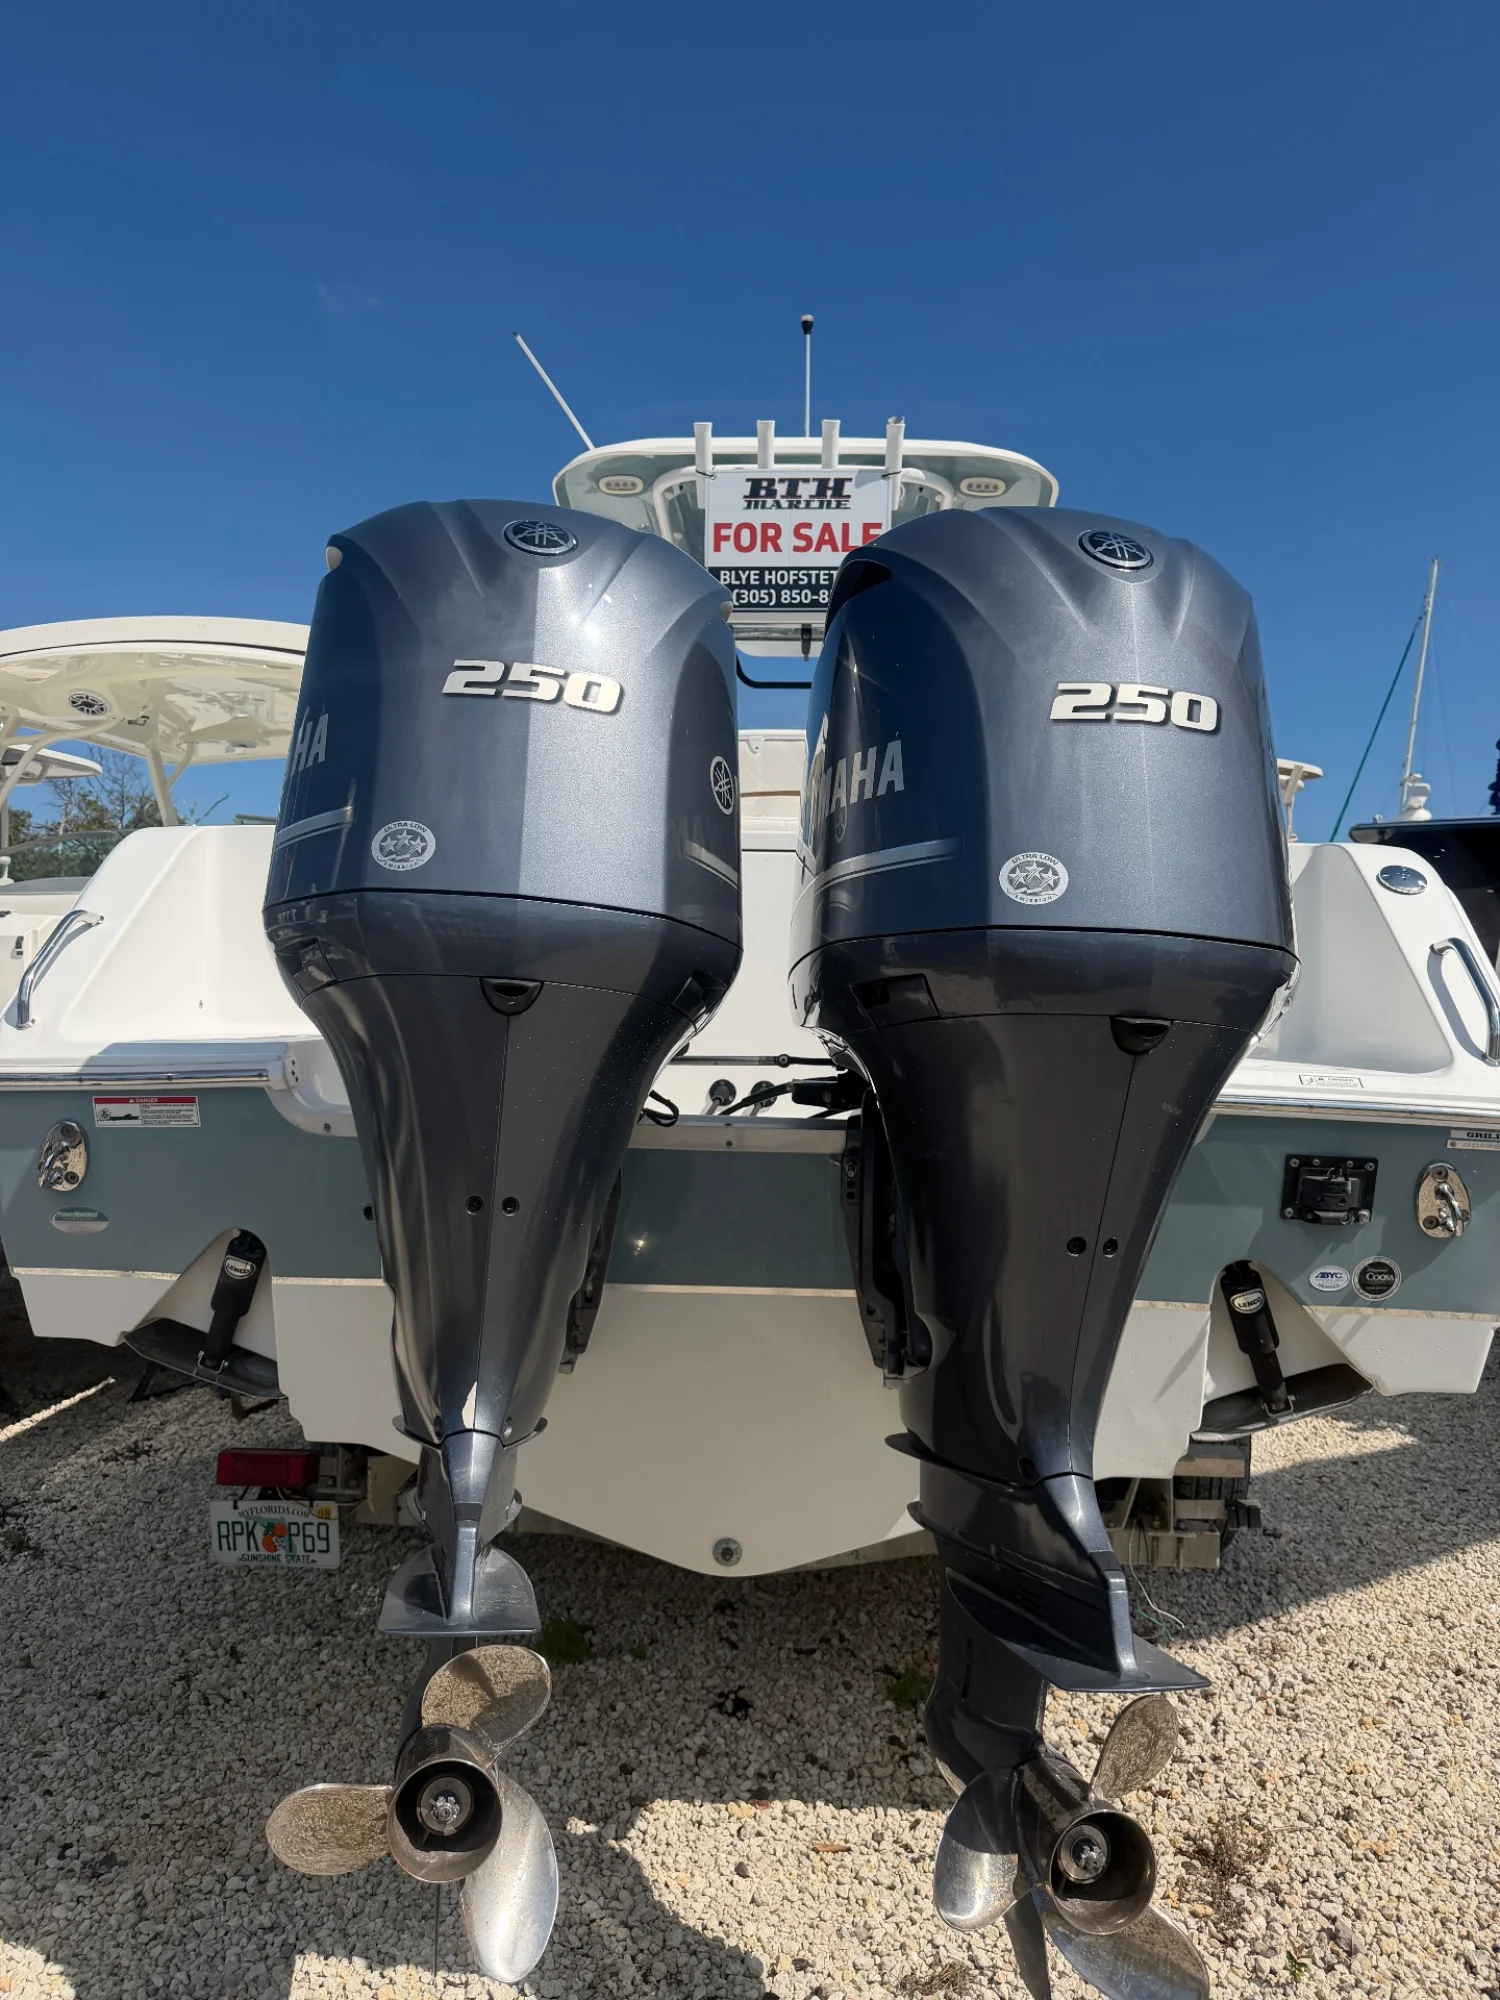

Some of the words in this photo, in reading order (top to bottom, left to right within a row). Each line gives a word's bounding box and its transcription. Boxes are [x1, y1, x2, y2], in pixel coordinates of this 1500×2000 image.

[743, 478, 853, 499] BTH
[742, 500, 852, 510] MARINE
[713, 522, 783, 553] FOR
[792, 522, 882, 553] SALE
[720, 570, 760, 585] BLYE
[732, 589, 776, 606] (305)
[442, 659, 621, 712] 250
[1050, 683, 1217, 731] 250
[1314, 1271, 1344, 1279] ABYC
[1237, 1296, 1261, 1308] LENCO
[238, 1505, 310, 1519] MYFLORIDA.COM
[217, 1521, 260, 1552] RPK
[288, 1521, 330, 1553] P69
[240, 1553, 282, 1563] SUNSHINE
[284, 1554, 311, 1564] STATE
